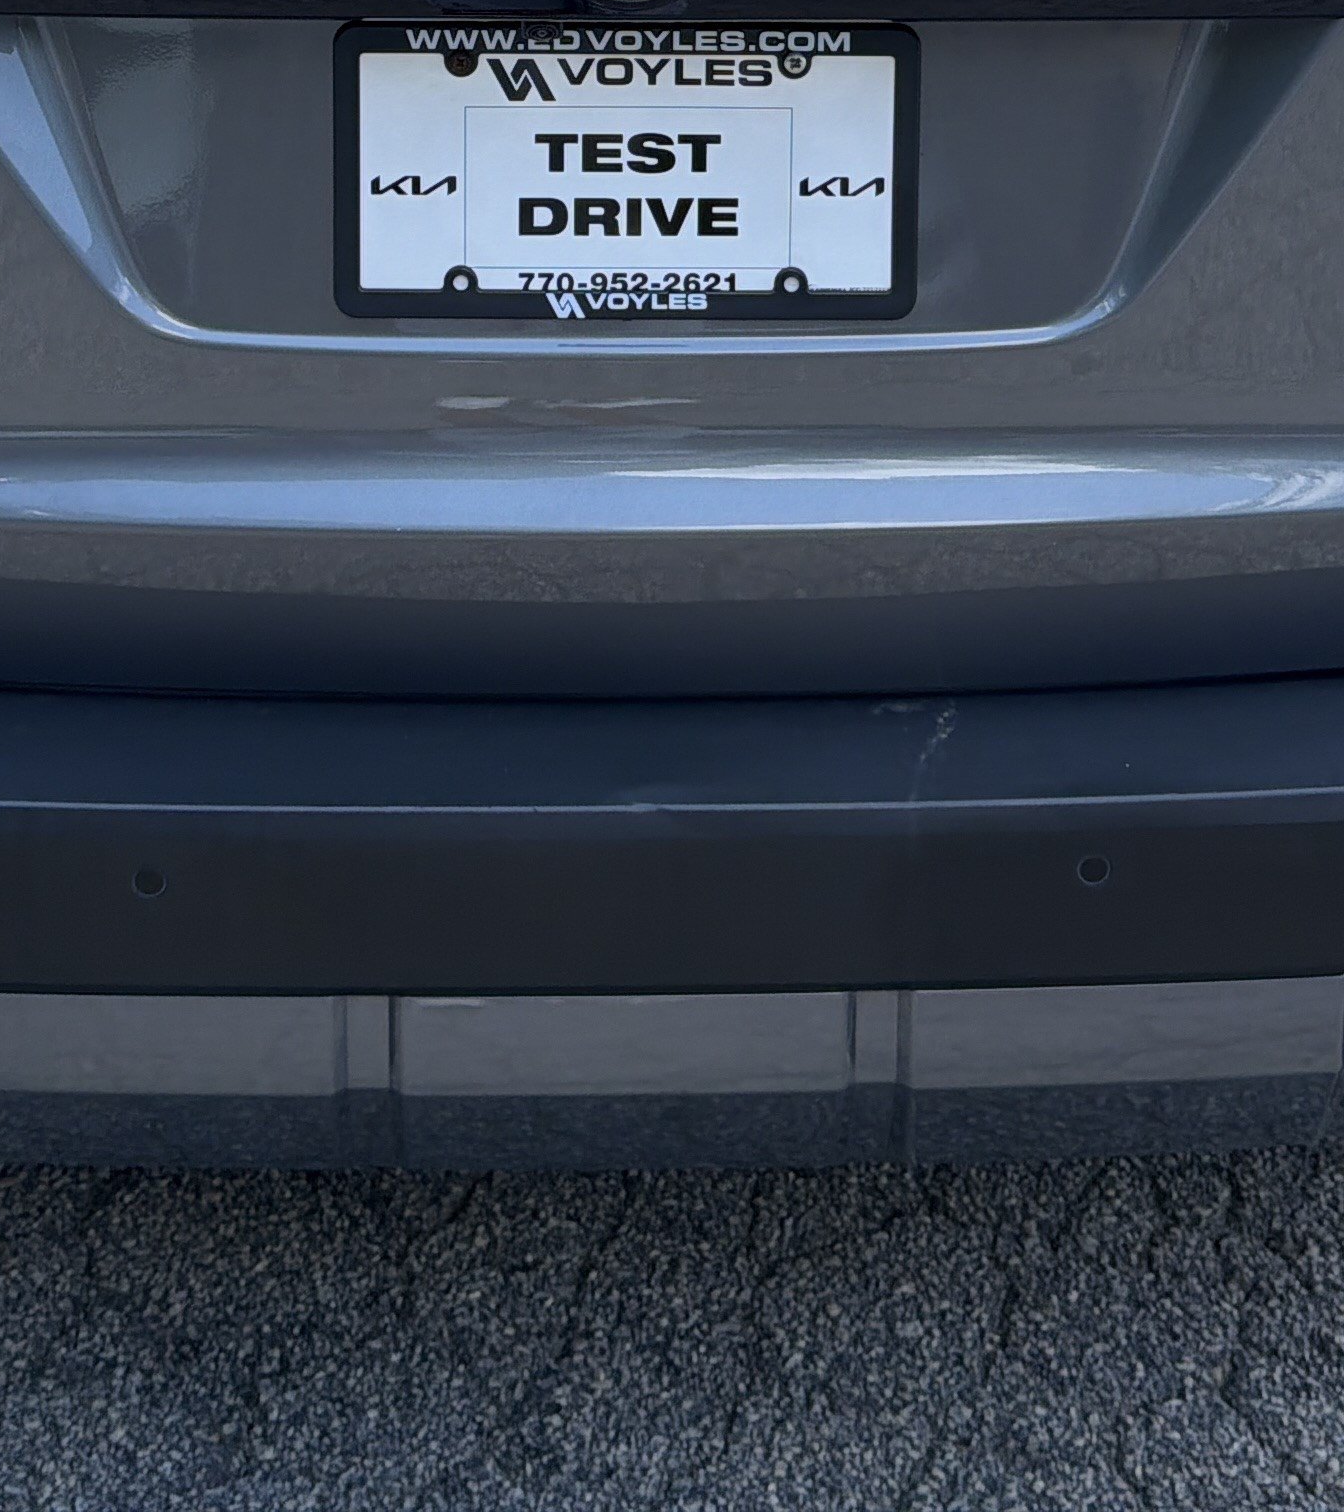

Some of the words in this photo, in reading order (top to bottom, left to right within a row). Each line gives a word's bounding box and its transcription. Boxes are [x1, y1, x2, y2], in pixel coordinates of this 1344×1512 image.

[557, 58, 773, 87] VOYLES
[534, 133, 721, 174] TEST
[517, 197, 739, 237] DRIVE
[518, 272, 737, 292] 770-952-2621
[585, 292, 708, 310] VOYLES
